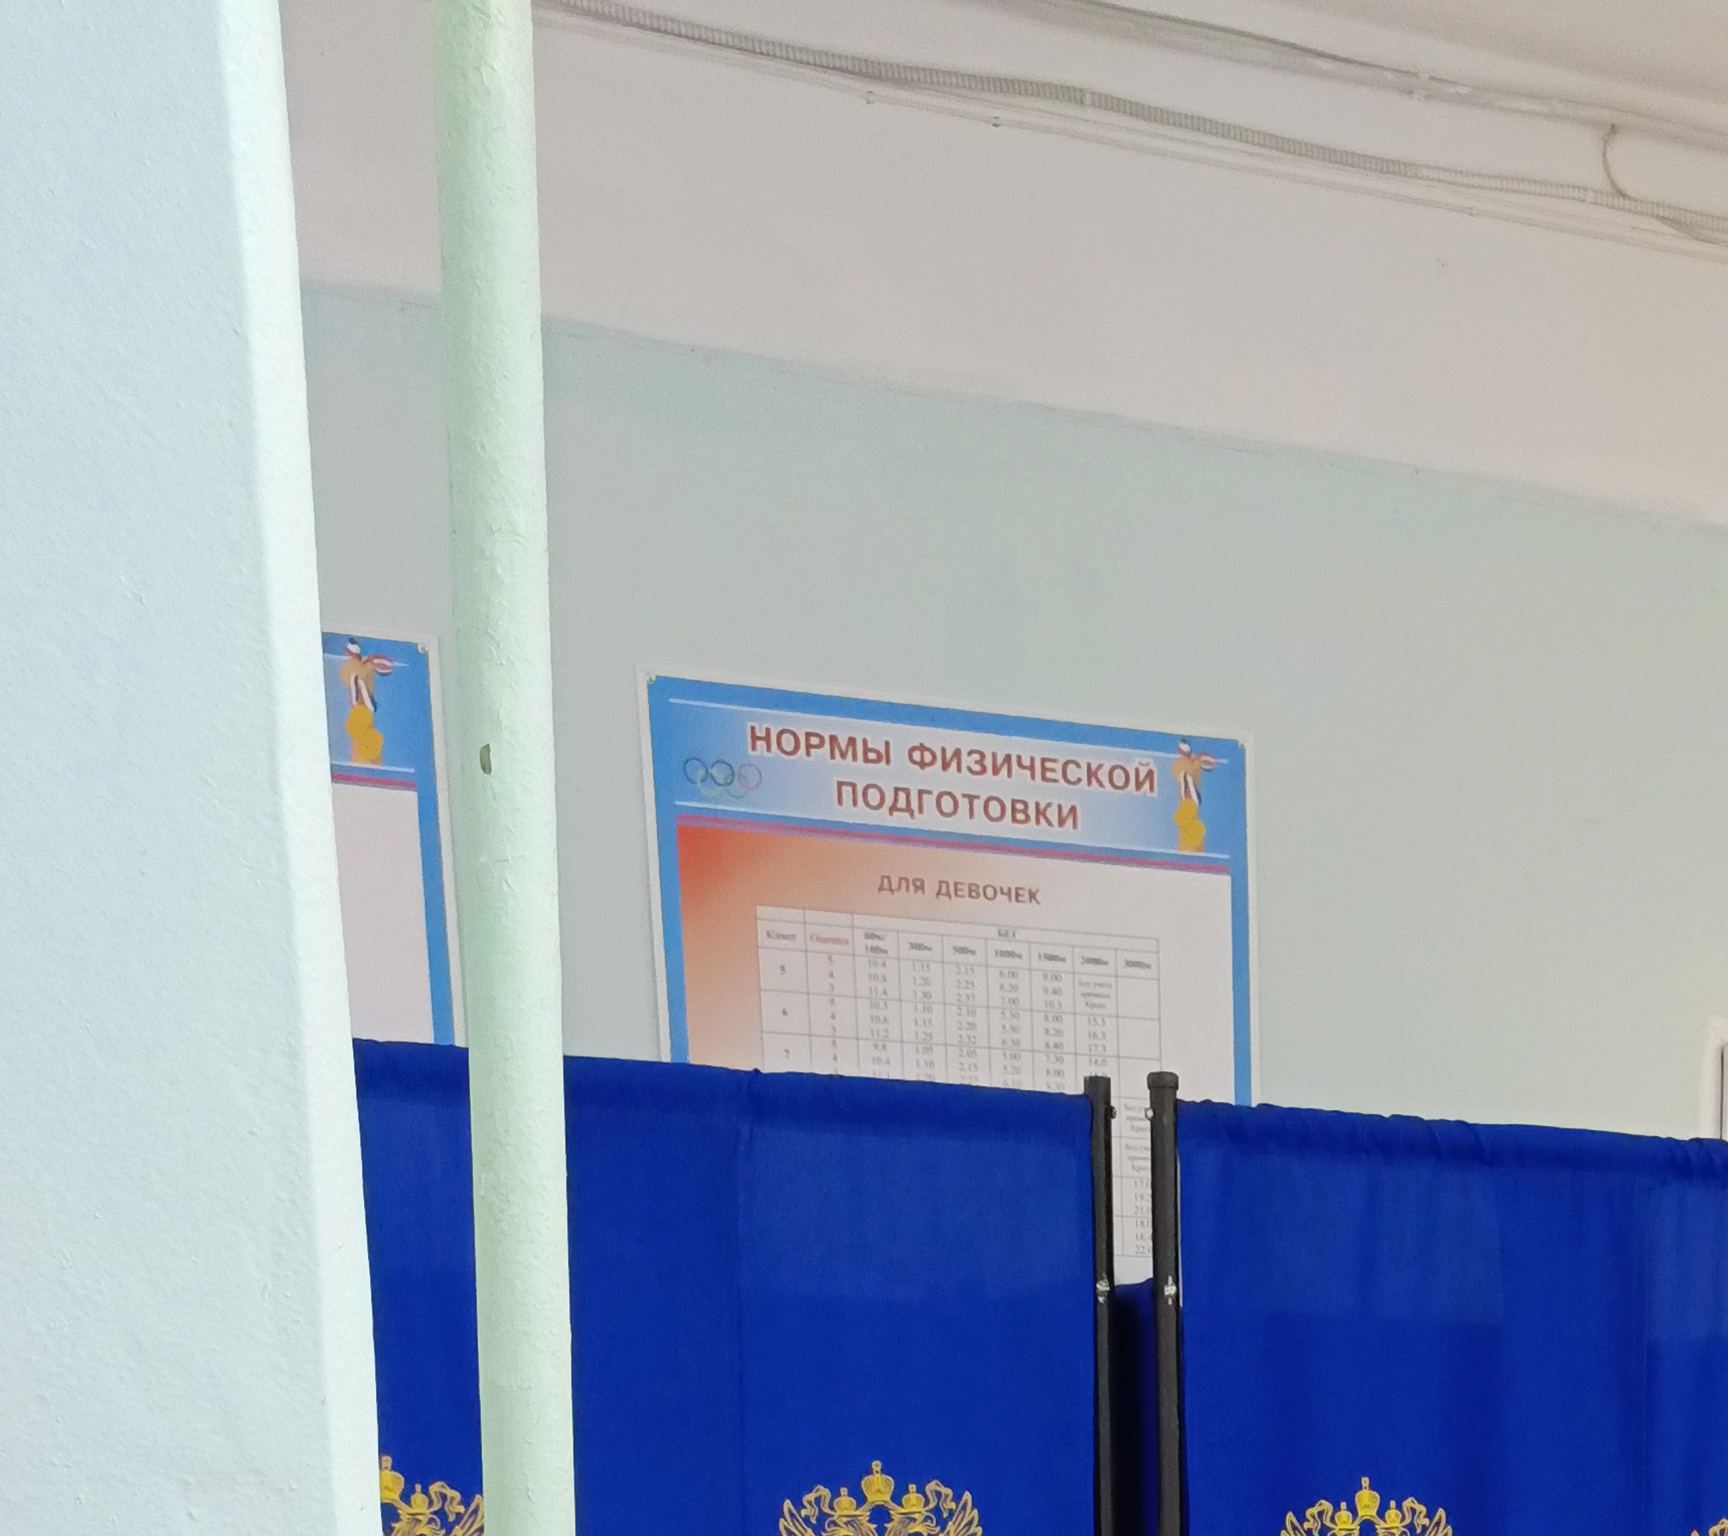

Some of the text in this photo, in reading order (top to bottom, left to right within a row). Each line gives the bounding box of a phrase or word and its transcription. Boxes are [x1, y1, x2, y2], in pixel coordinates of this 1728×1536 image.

[749, 724, 1156, 794] НОРМЫ ФИЗИЧЕСКОЙ
[835, 779, 1080, 831] ПОДГОТОВКИ
[877, 874, 1042, 905] ДЛЯ ДЕВОЧЕК
